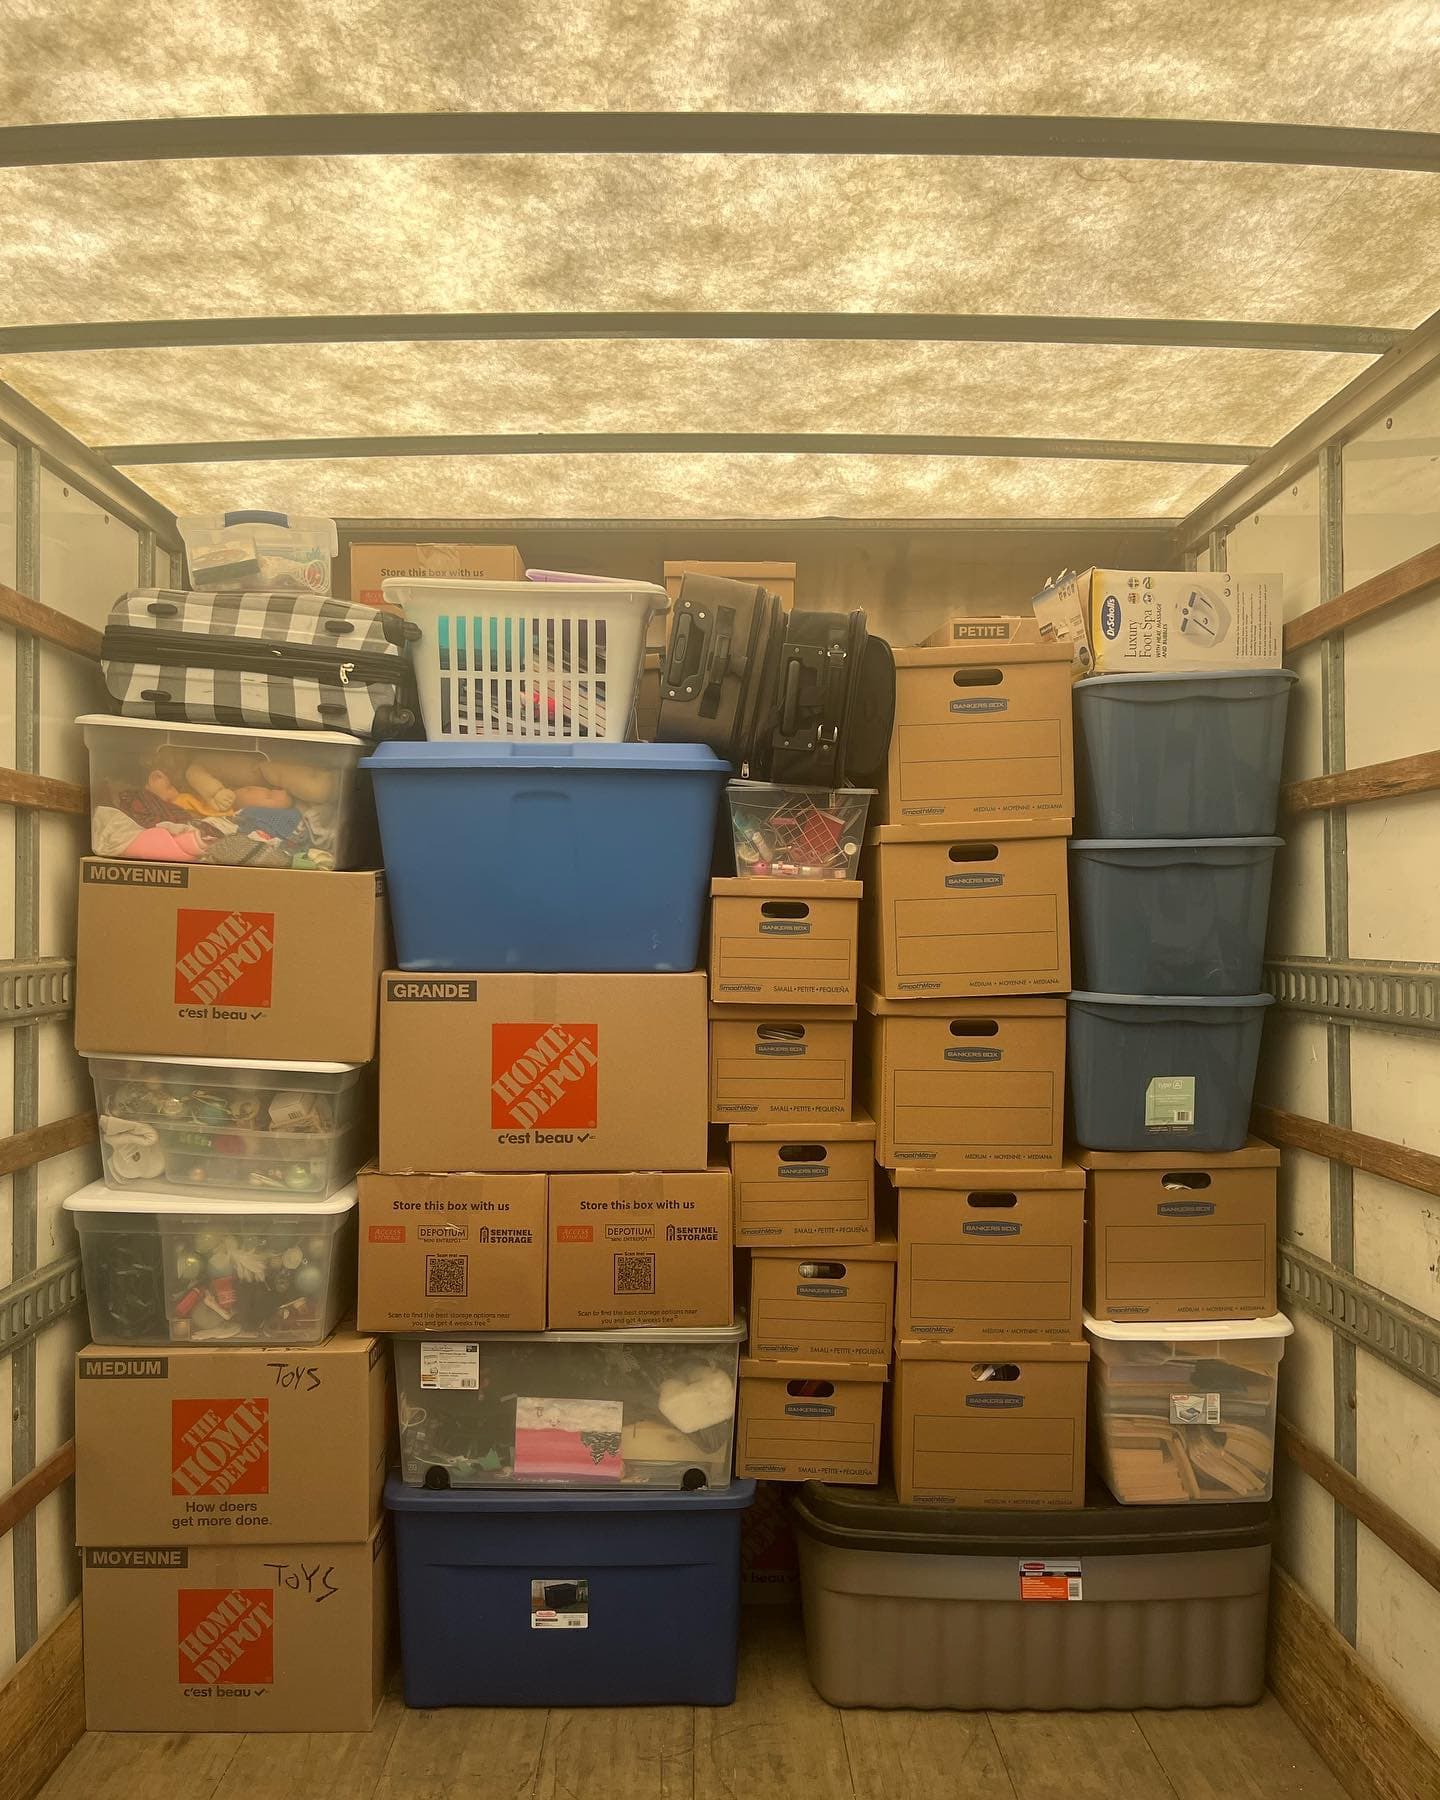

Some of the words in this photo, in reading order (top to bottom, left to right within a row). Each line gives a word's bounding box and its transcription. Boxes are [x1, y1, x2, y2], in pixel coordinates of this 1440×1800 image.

[380, 567, 406, 577] Store
[408, 567, 426, 577] this
[429, 568, 447, 577] box
[450, 568, 469, 577] with
[473, 570, 484, 578] us
[1139, 609, 1155, 630] Spa
[958, 626, 1005, 637] PETITE
[1124, 619, 1140, 658] Luxury
[1139, 632, 1152, 658] Foot
[90, 865, 181, 884] MOYENNE
[176, 911, 252, 983] HOME
[191, 925, 273, 1006] DEPOT
[393, 984, 470, 999] GRANDE
[178, 1008, 208, 1019] c'est
[212, 1008, 248, 1020] beau
[492, 1024, 575, 1105] HOME
[509, 1037, 598, 1129] DEPOT
[498, 1132, 530, 1144] c'est
[535, 1131, 574, 1144] beau
[392, 1200, 423, 1211] Store
[424, 1200, 445, 1211] this
[447, 1201, 468, 1211] box
[470, 1201, 495, 1211] with
[498, 1203, 510, 1211] us
[580, 1201, 608, 1210] Store
[611, 1200, 631, 1210] this
[633, 1200, 653, 1210] box
[656, 1200, 680, 1209] with
[683, 1201, 695, 1209] us
[607, 1227, 652, 1236] DEPOTIUM
[490, 1236, 533, 1244] STORAGE
[86, 1361, 161, 1375] MEDIUM
[180, 1408, 222, 1448] THE
[172, 1398, 269, 1496] HOME
[210, 1433, 270, 1495] DEPOT
[185, 1501, 215, 1513] How
[219, 1501, 257, 1513] doers
[172, 1515, 194, 1528] get
[197, 1517, 232, 1526] more
[235, 1515, 272, 1526] done.
[92, 1550, 181, 1565] MOYENNE
[178, 1590, 252, 1663] HOME
[194, 1601, 273, 1684] DEPOT
[184, 1687, 212, 1698] c'est
[216, 1686, 251, 1698] beau
